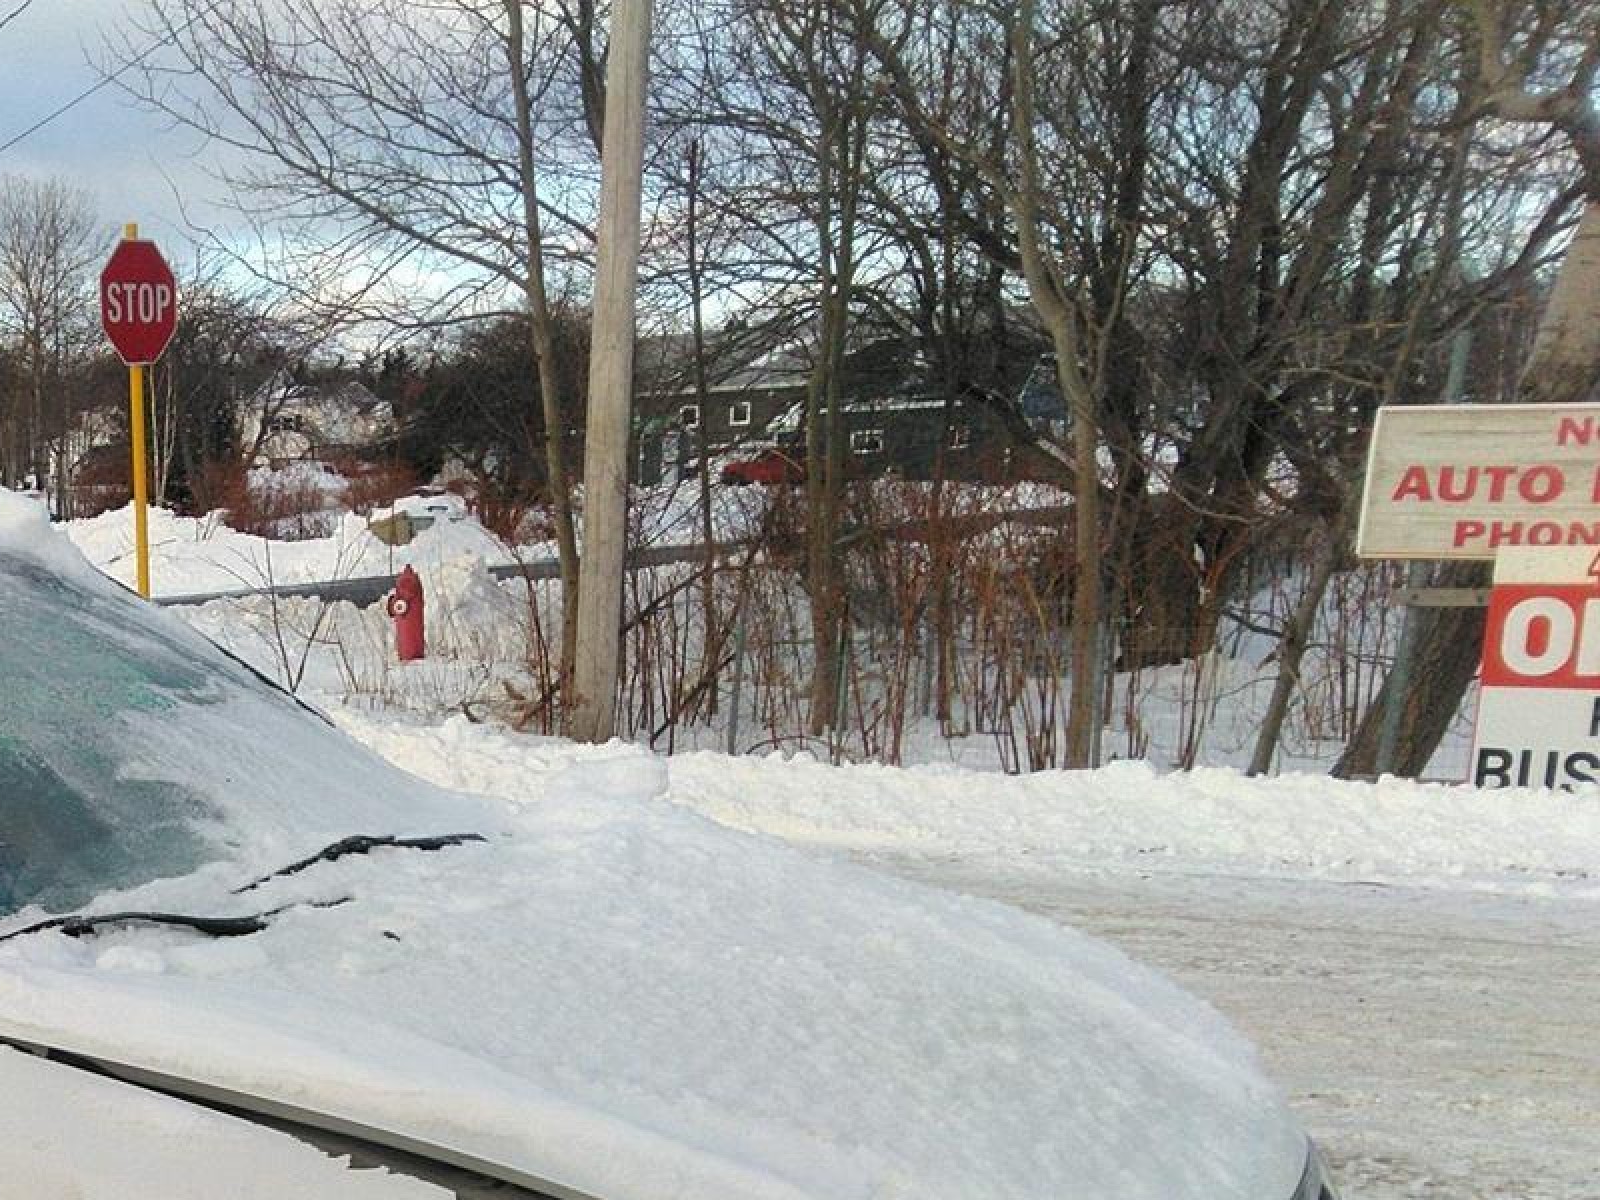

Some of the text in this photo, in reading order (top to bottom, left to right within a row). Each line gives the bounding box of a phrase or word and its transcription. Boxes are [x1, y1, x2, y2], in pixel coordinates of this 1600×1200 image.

[107, 283, 171, 323] STOP
[1557, 416, 1600, 447] N
[1392, 465, 1566, 503] AUTO
